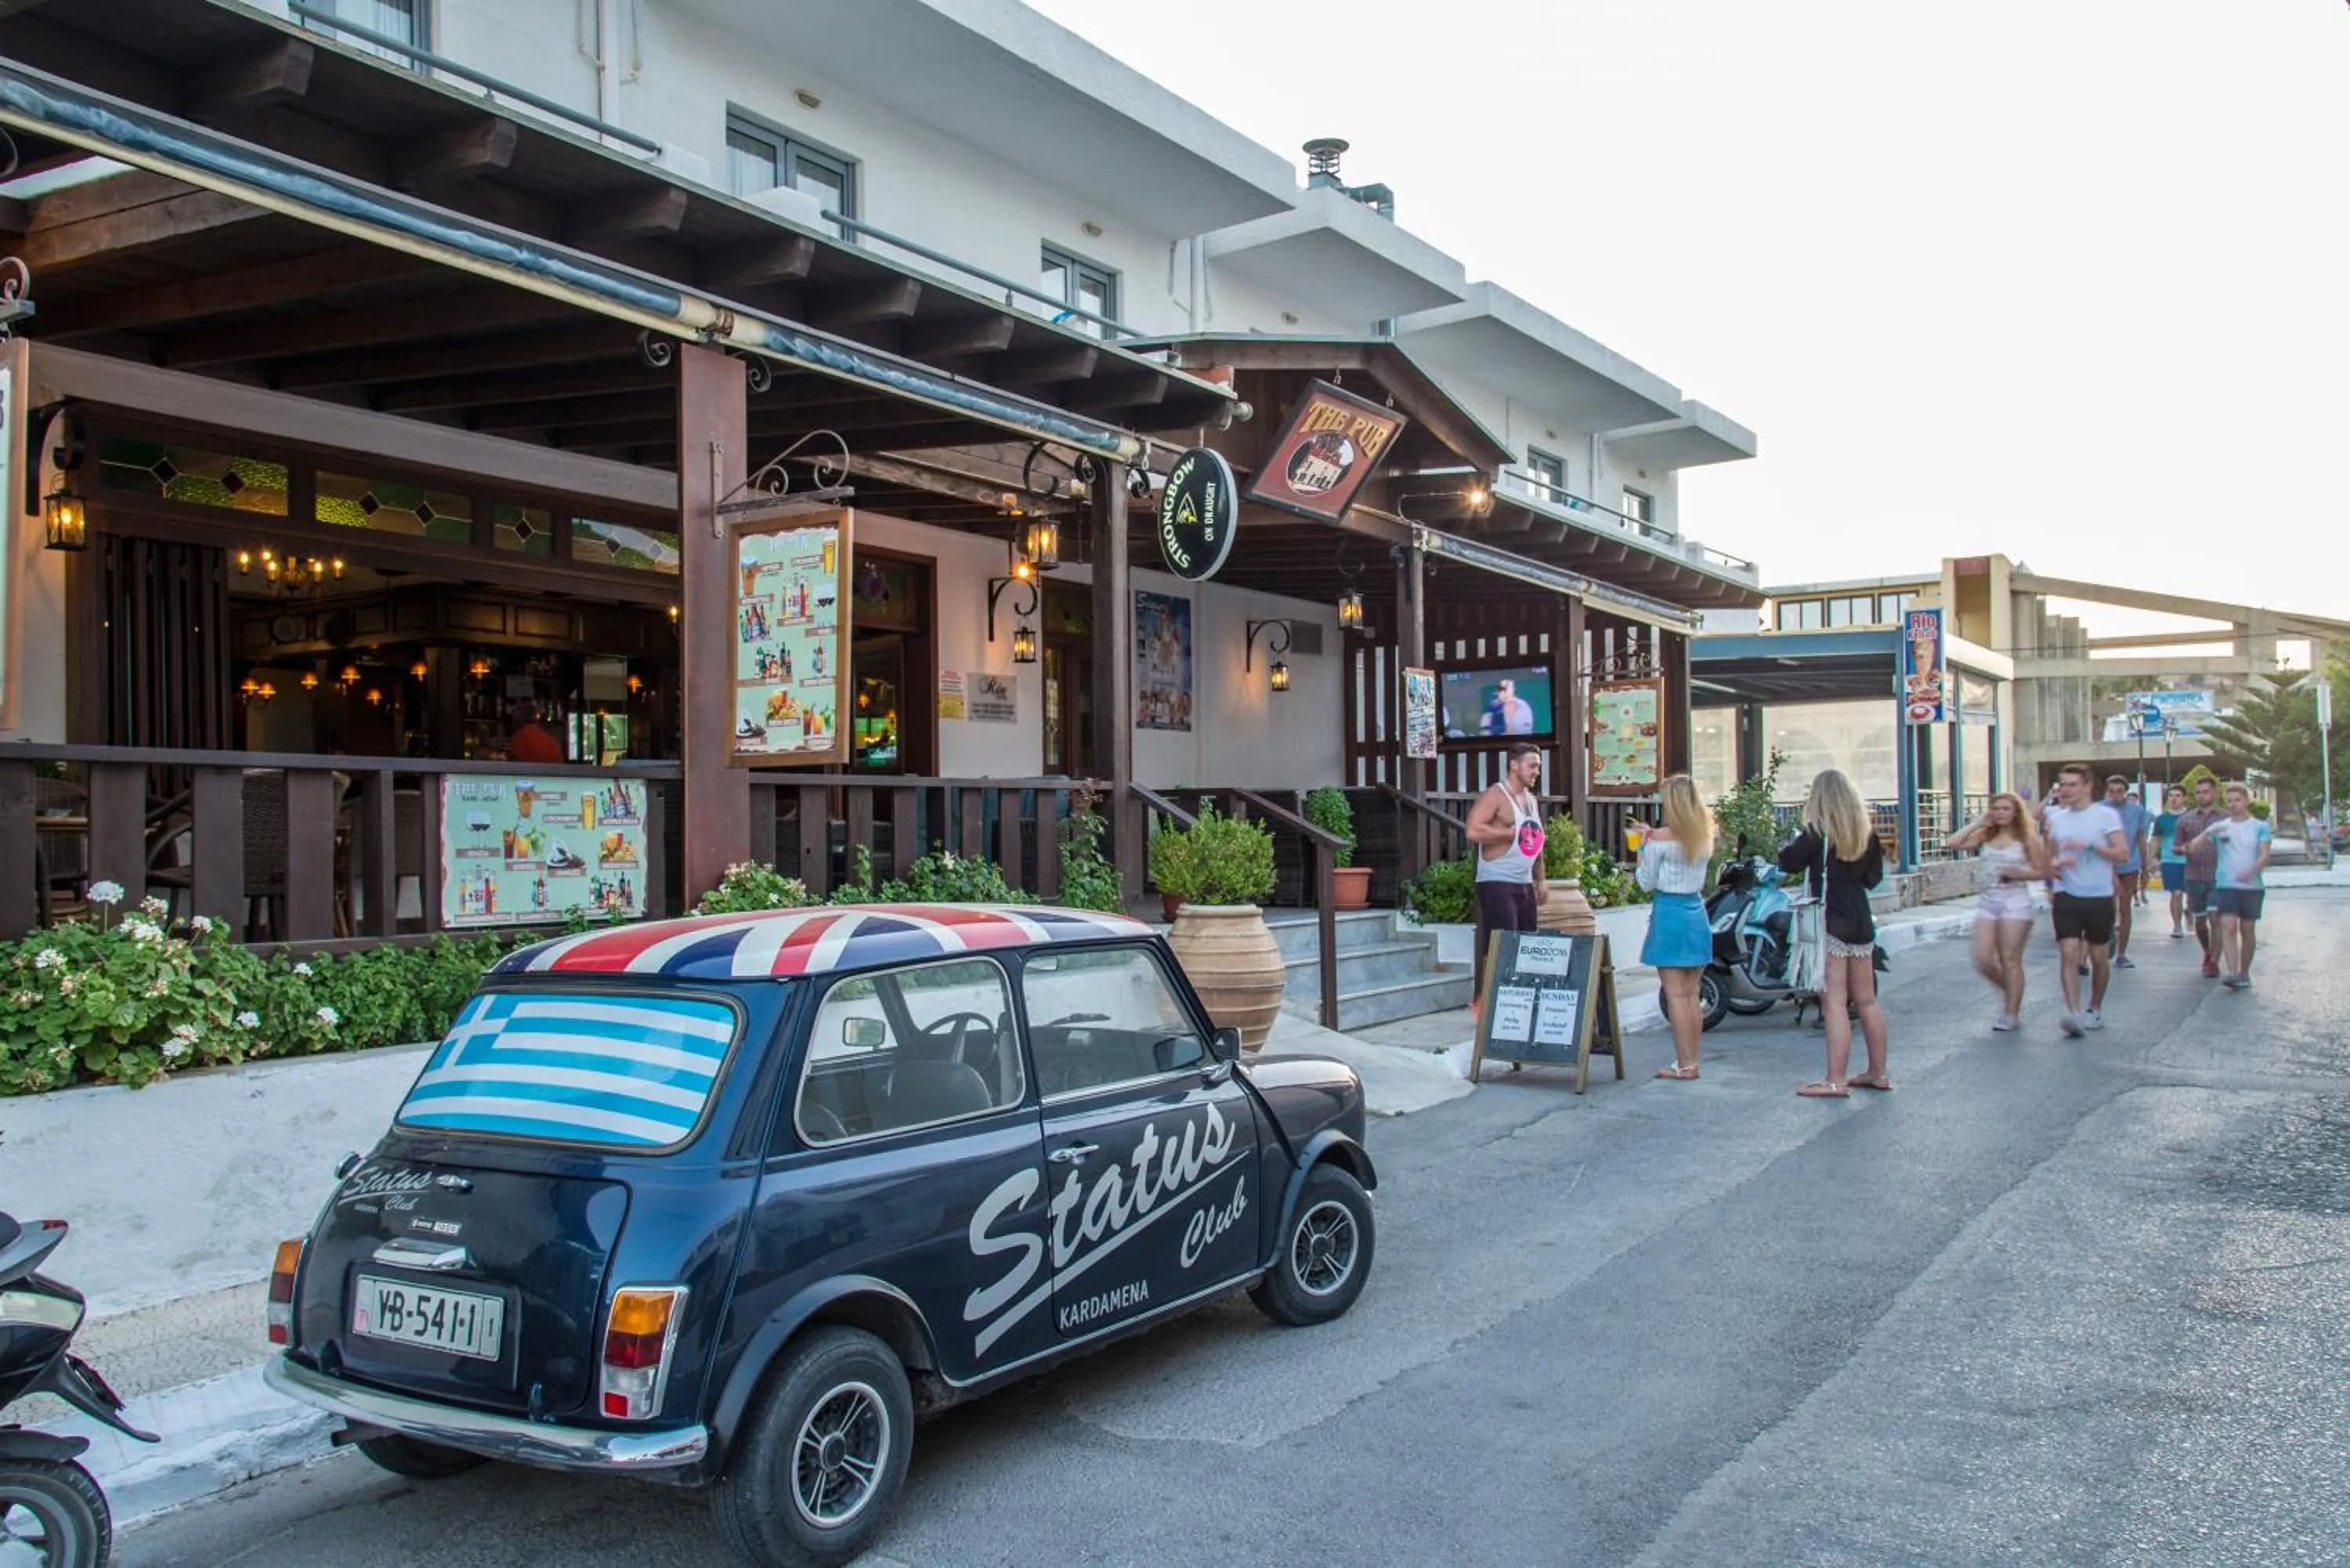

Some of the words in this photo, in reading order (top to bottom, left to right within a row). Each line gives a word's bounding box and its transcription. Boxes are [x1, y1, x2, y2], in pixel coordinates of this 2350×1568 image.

[1163, 457, 1195, 569] STRONGBOW
[1204, 481, 1217, 525] DRAUGHT
[1204, 526, 1214, 542] ON
[345, 1166, 433, 1194] Status
[385, 1194, 420, 1211] Club
[963, 1101, 1236, 1322] Status
[1180, 1175, 1248, 1268] Club
[1059, 1278, 1149, 1330] KARDAMENA
